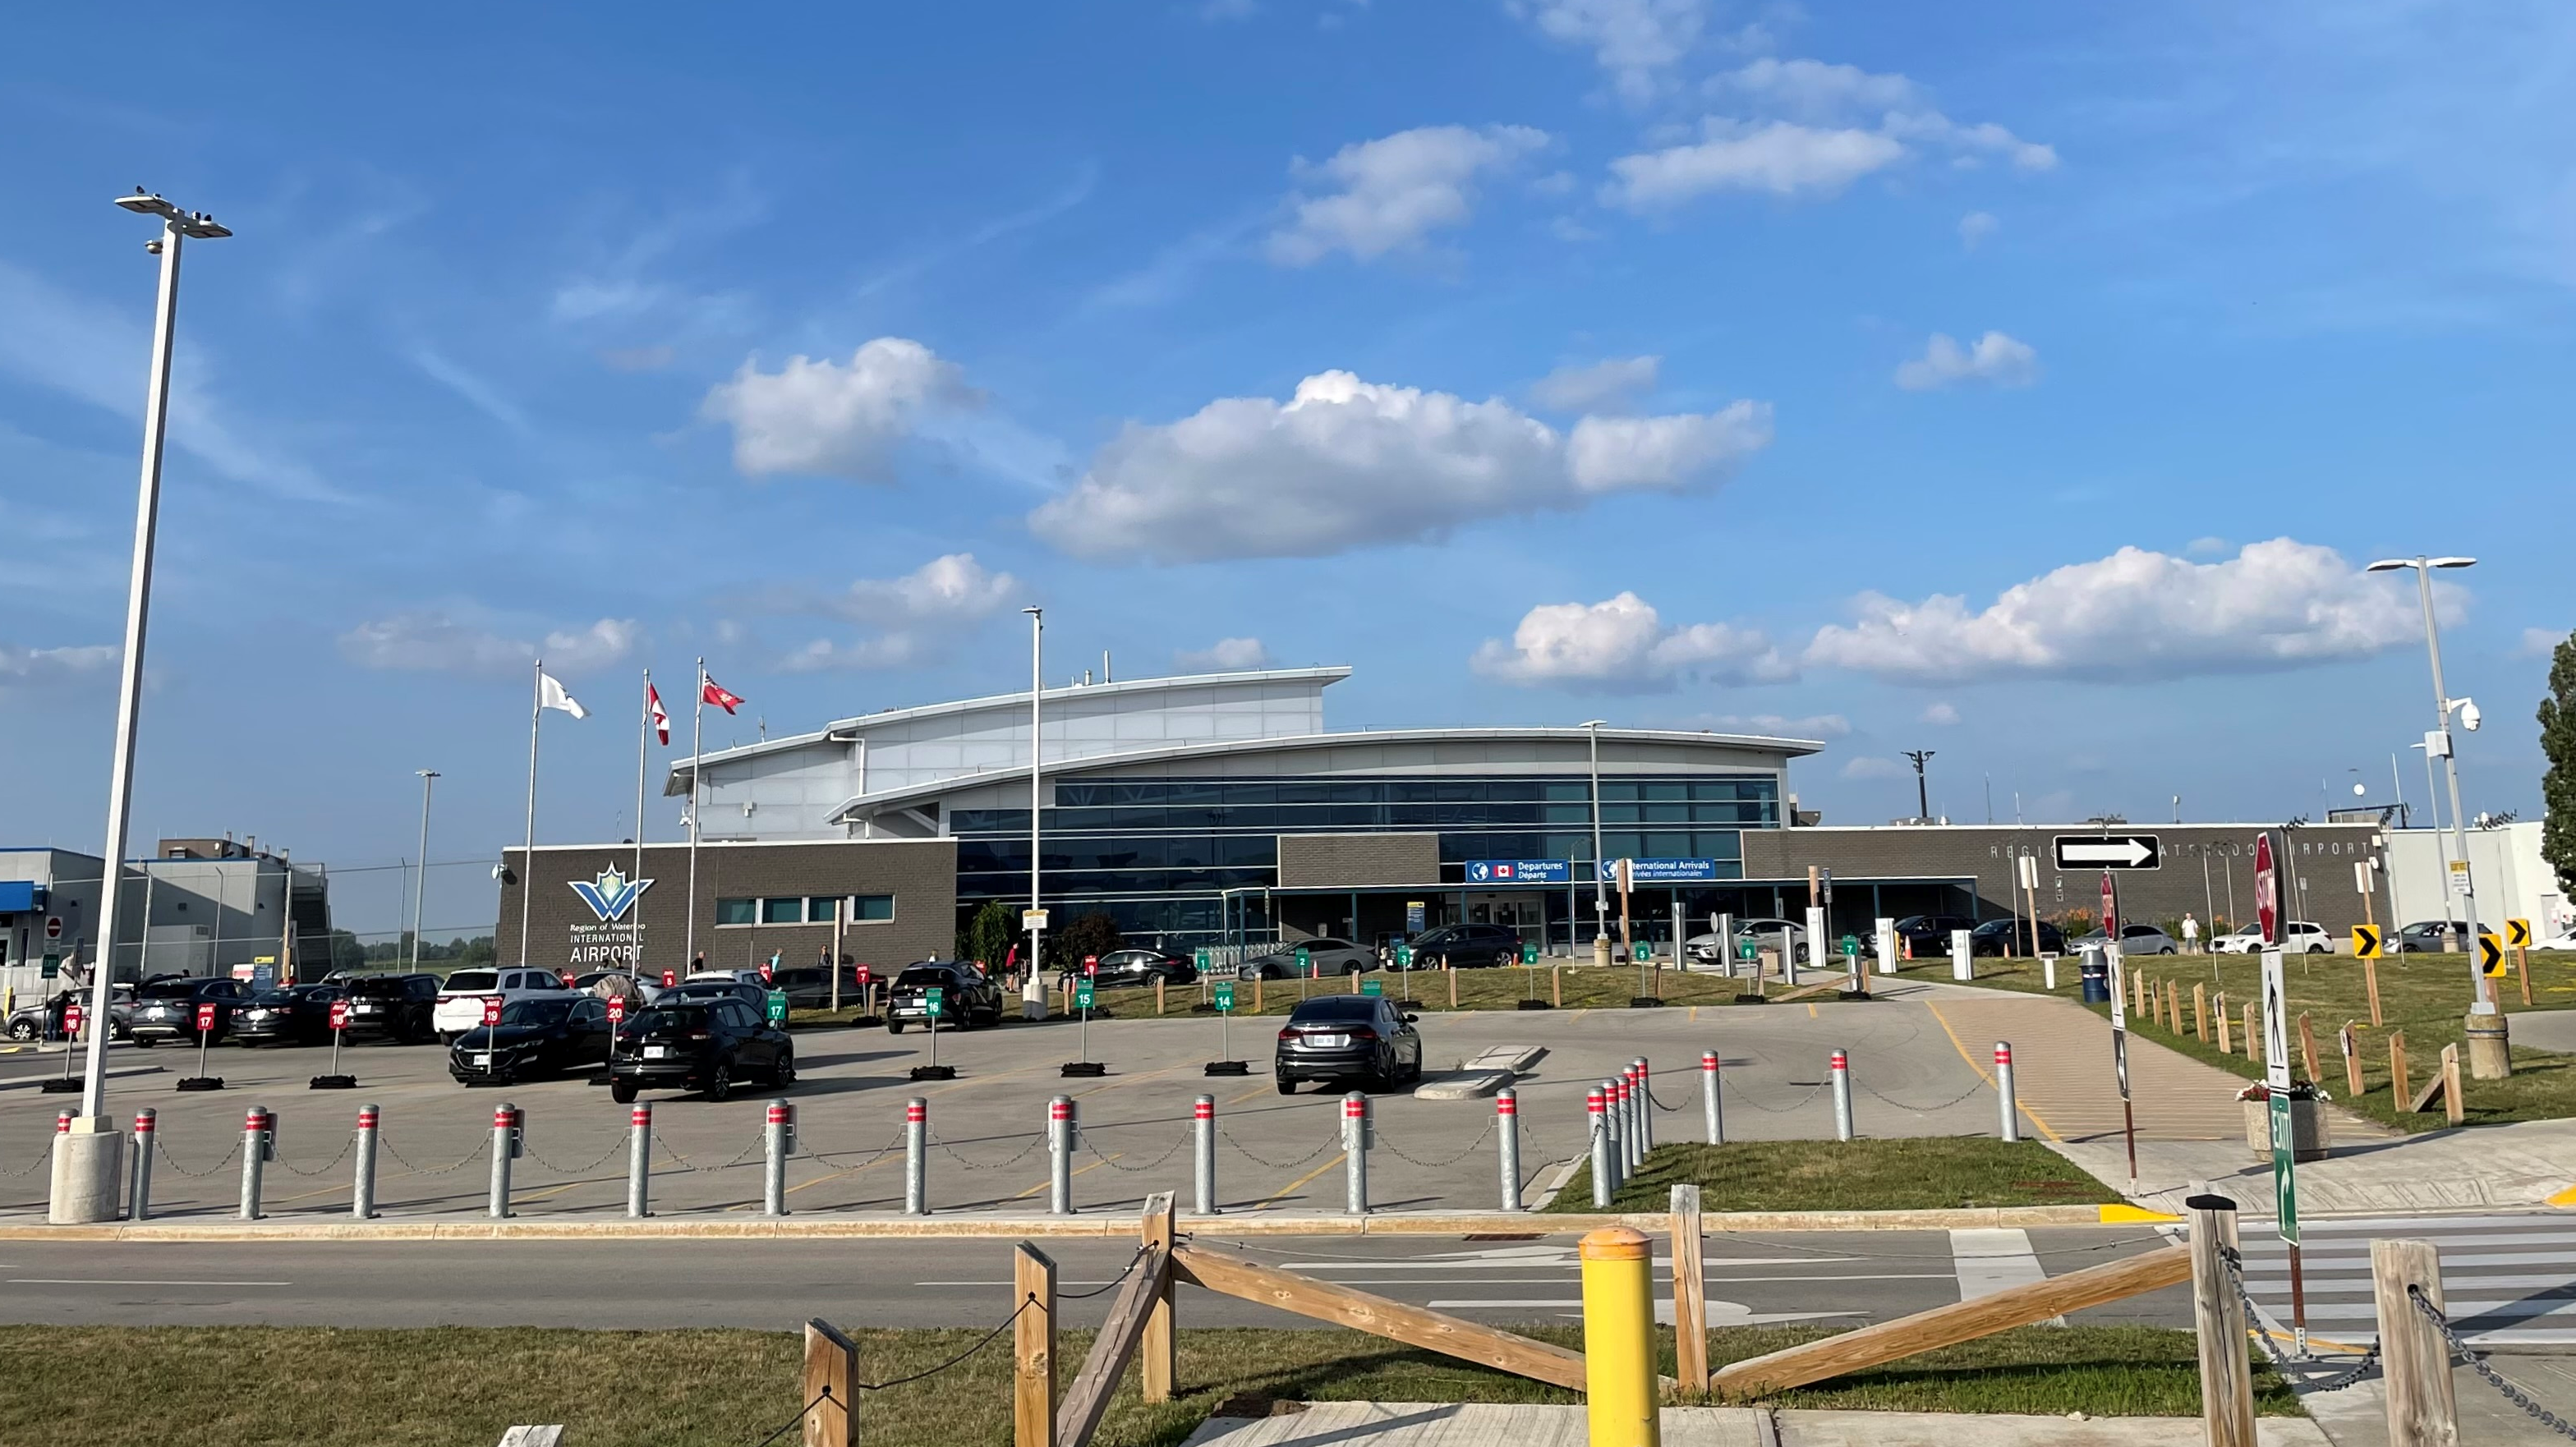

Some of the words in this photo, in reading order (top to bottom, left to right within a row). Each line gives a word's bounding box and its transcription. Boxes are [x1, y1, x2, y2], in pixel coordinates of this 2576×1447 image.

[1990, 845, 2054, 858] REGIO
[2293, 842, 2368, 855] IRPORT
[1518, 861, 1563, 871] Departures
[1632, 861, 1677, 870] ternational
[1678, 861, 1710, 870] Arrivals
[1518, 871, 1548, 880] Départs
[569, 924, 597, 933] Region
[599, 923, 609, 931] of
[570, 933, 644, 944] INTERNATIONL
[569, 945, 644, 963] AIRPORT
[1527, 954, 1534, 962] 4
[1300, 958, 1306, 966] 2
[1079, 994, 1091, 1004] 15
[1217, 995, 1230, 1007] 14
[770, 1005, 783, 1016] 17
[928, 1002, 939, 1013] 16
[486, 1010, 499, 1022] 19
[608, 1008, 623, 1019] 20
[67, 1018, 77, 1030] 16
[200, 1017, 212, 1027] 17
[332, 1013, 344, 1026] 18
[2273, 1110, 2290, 1151] EXIT
